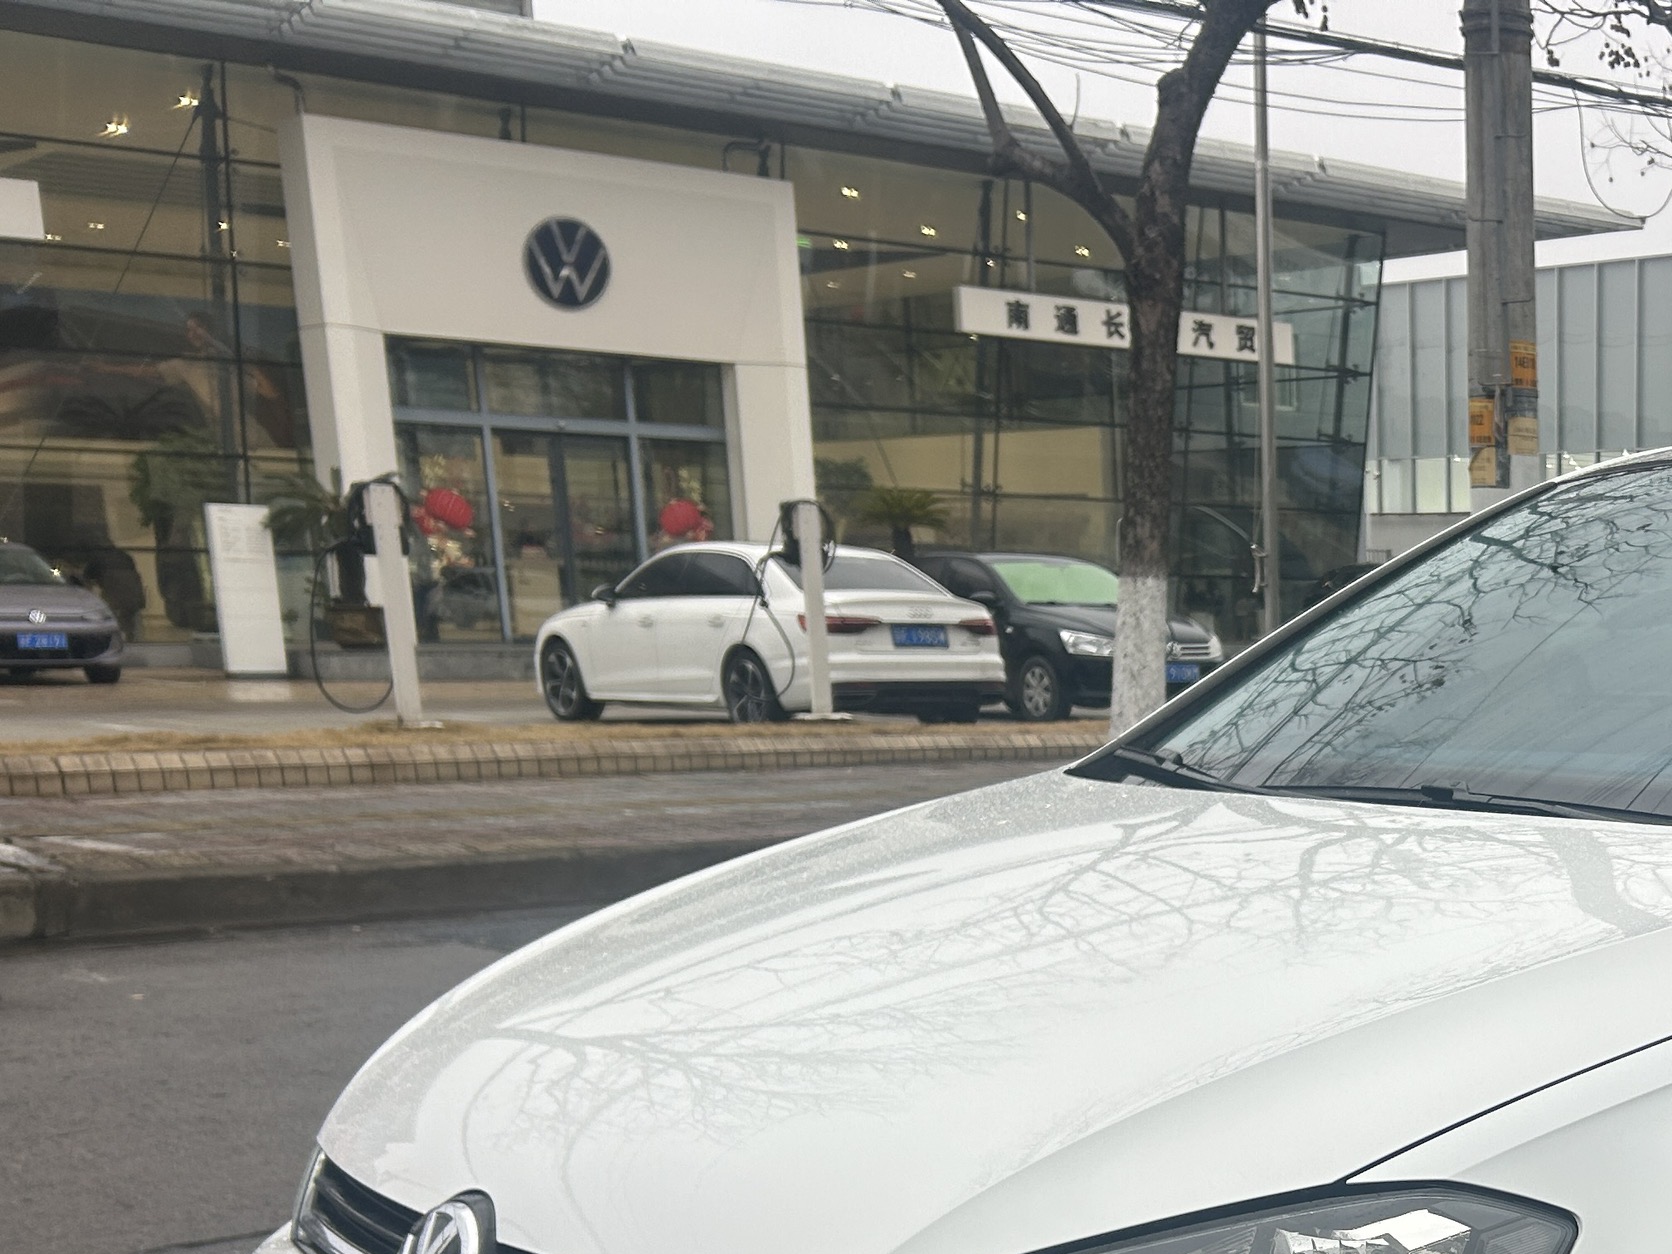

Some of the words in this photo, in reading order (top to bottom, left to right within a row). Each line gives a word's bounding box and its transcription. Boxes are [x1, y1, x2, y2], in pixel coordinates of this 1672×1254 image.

[1006, 299, 1256, 353] 南通长汽贸
